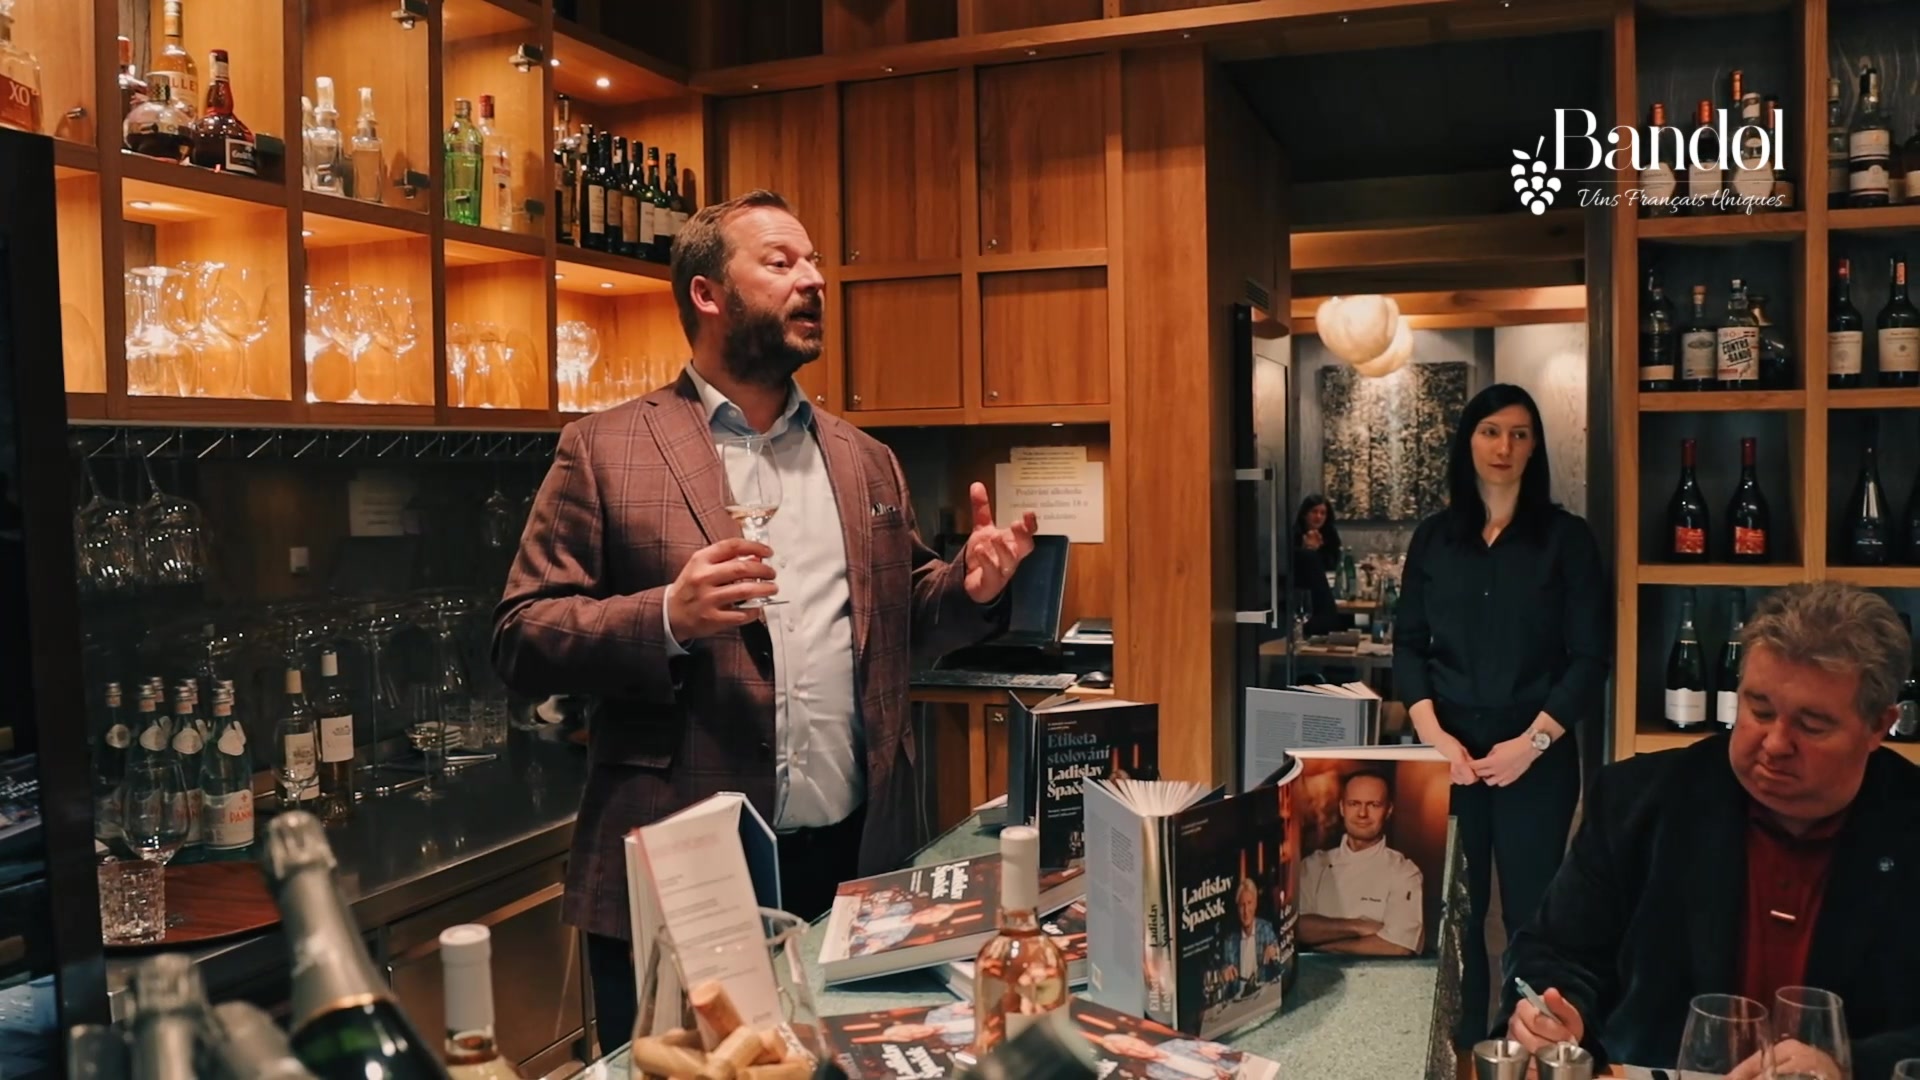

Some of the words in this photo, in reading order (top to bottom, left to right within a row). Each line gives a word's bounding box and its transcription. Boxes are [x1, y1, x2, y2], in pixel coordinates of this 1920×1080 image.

[9, 80, 30, 106] XO
[1048, 732, 1097, 748] Etiketa
[1047, 744, 1111, 765] stolování
[1047, 763, 1104, 783] Ladislav
[1047, 779, 1084, 801] Špač
[1182, 875, 1234, 907] Ladislav
[1148, 903, 1158, 948] Ladislav
[1181, 897, 1227, 933] Špaček
